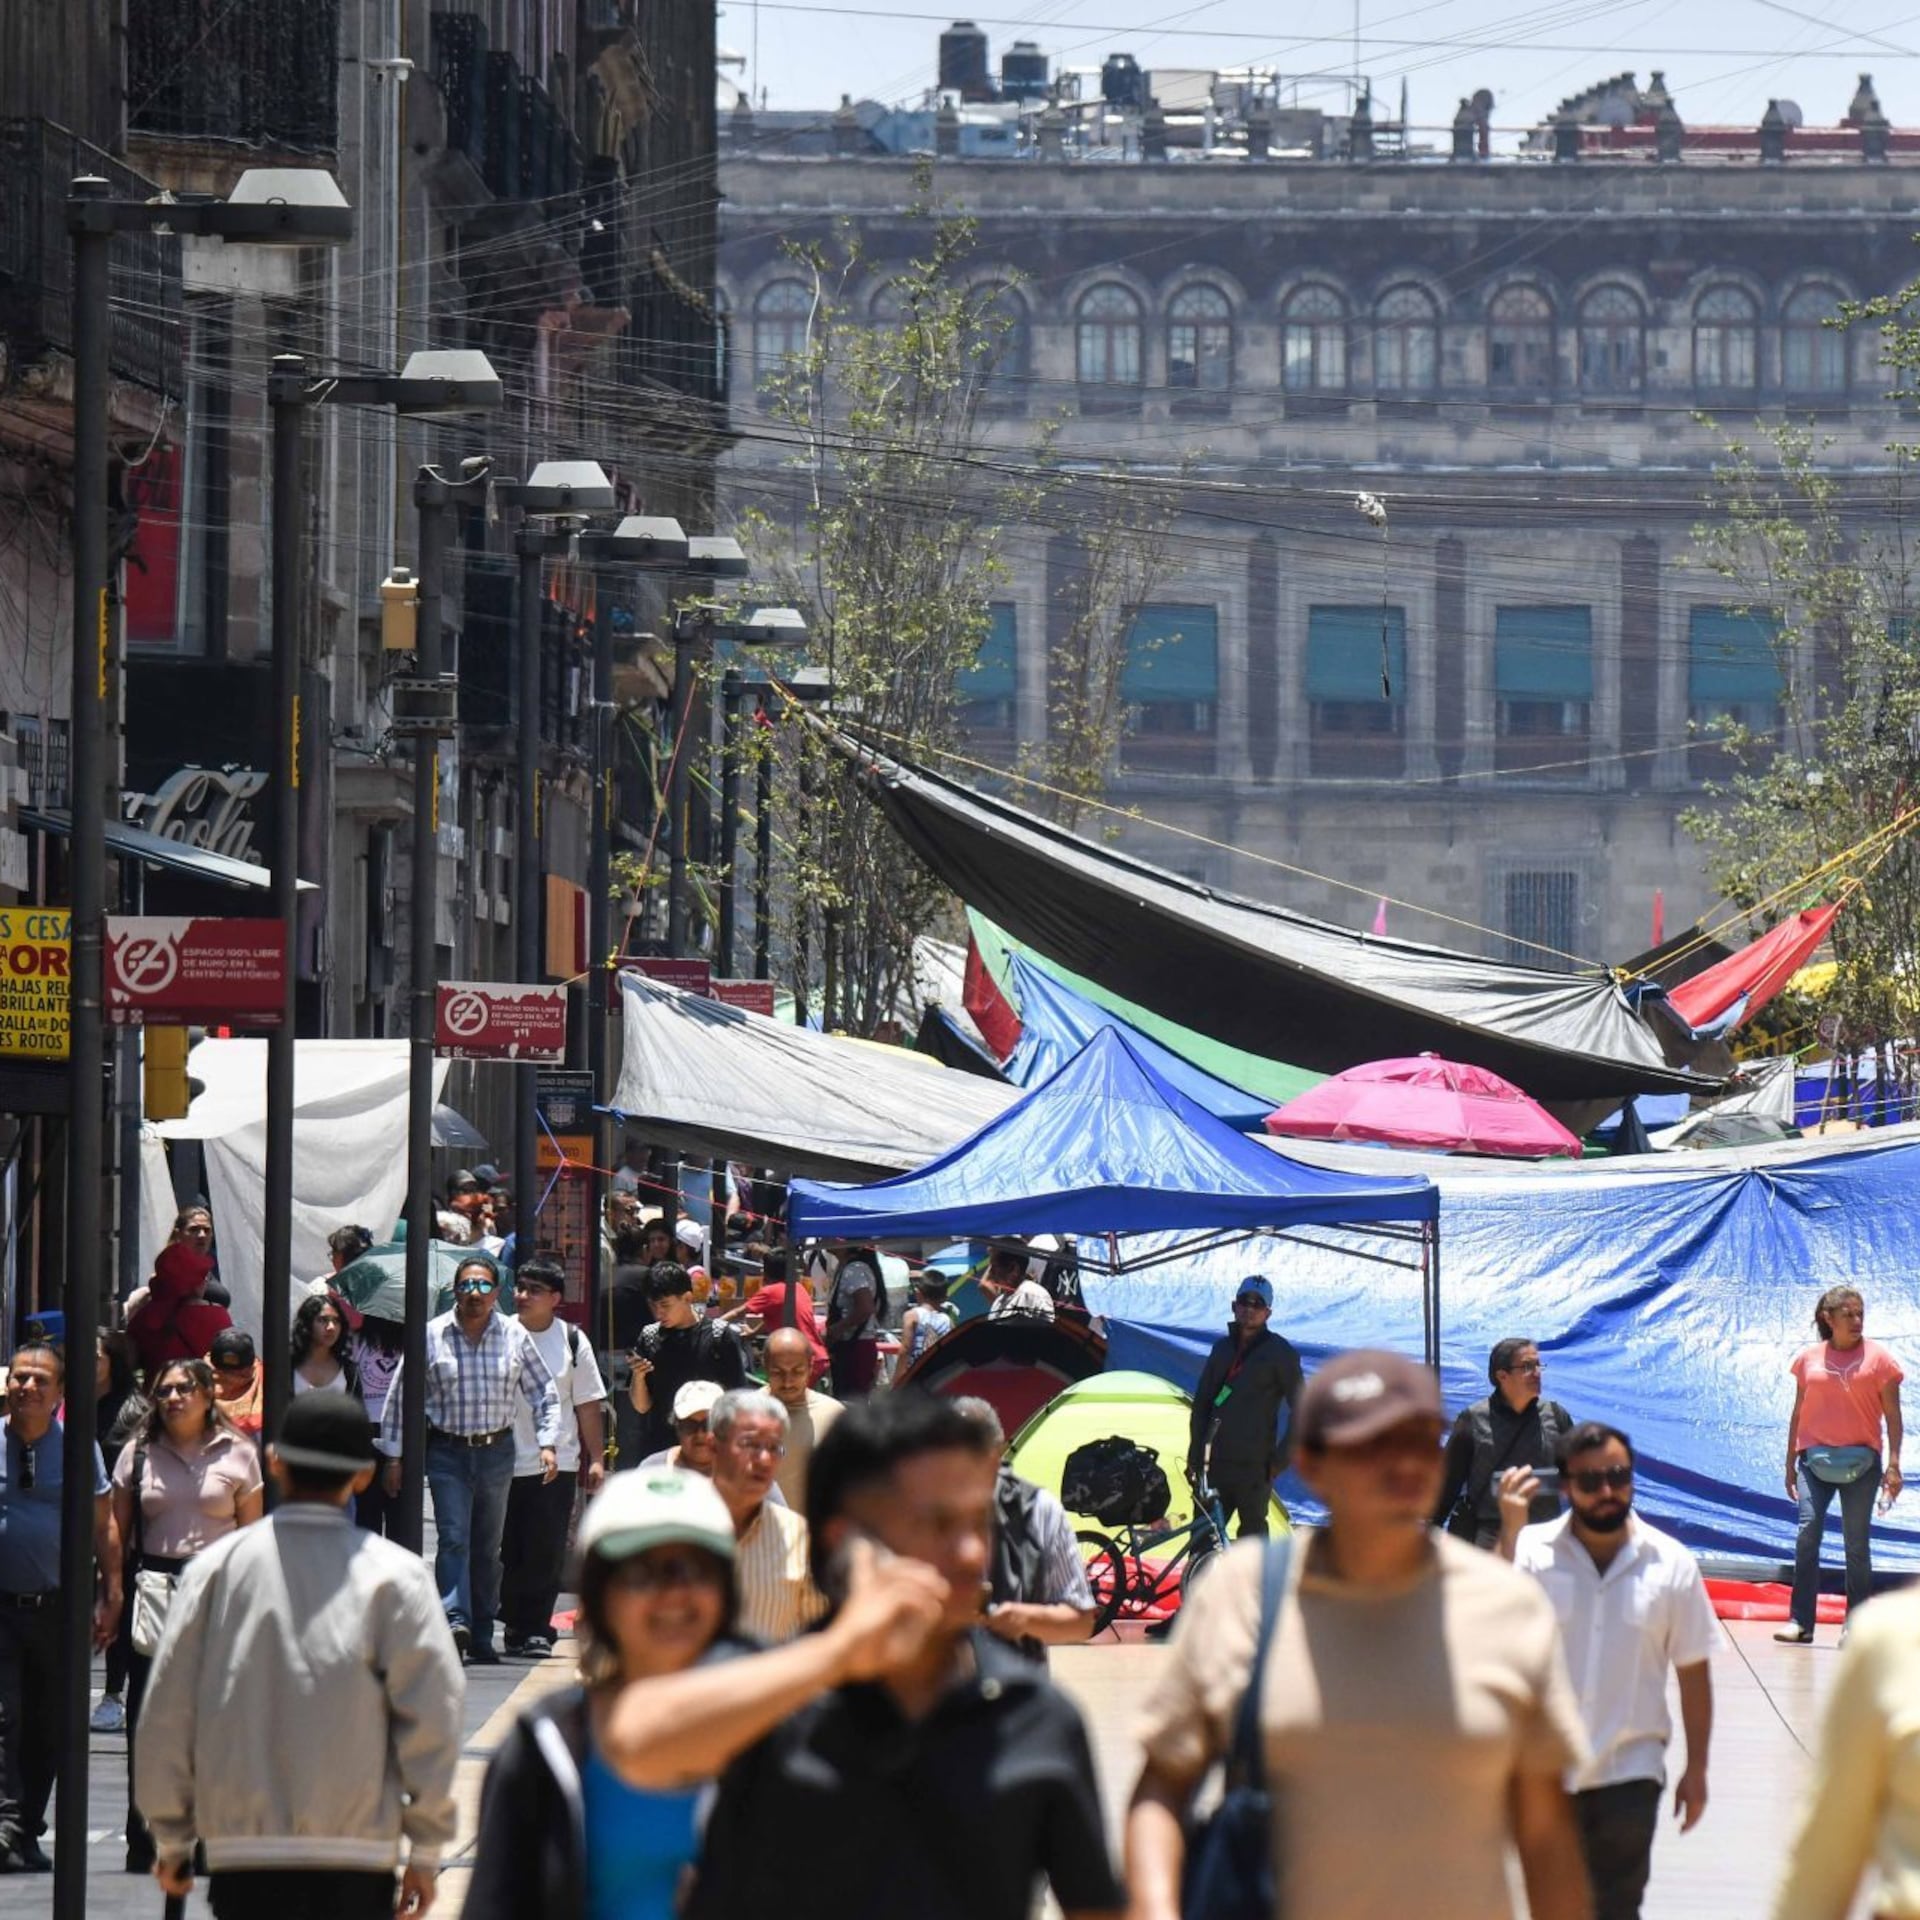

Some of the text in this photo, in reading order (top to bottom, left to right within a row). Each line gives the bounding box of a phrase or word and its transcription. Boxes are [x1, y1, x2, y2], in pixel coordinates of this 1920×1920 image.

[148, 769, 269, 862] Cola
[182, 948, 281, 958] ESPACIO 100% LIBRE
[182, 959, 196, 967] DE
[198, 959, 229, 968] HUMO
[230, 959, 244, 968] EN
[182, 969, 225, 978] CENTRO
[19, 1033, 63, 1050] ROTOS
[1056, 1269, 1078, 1296] NY
